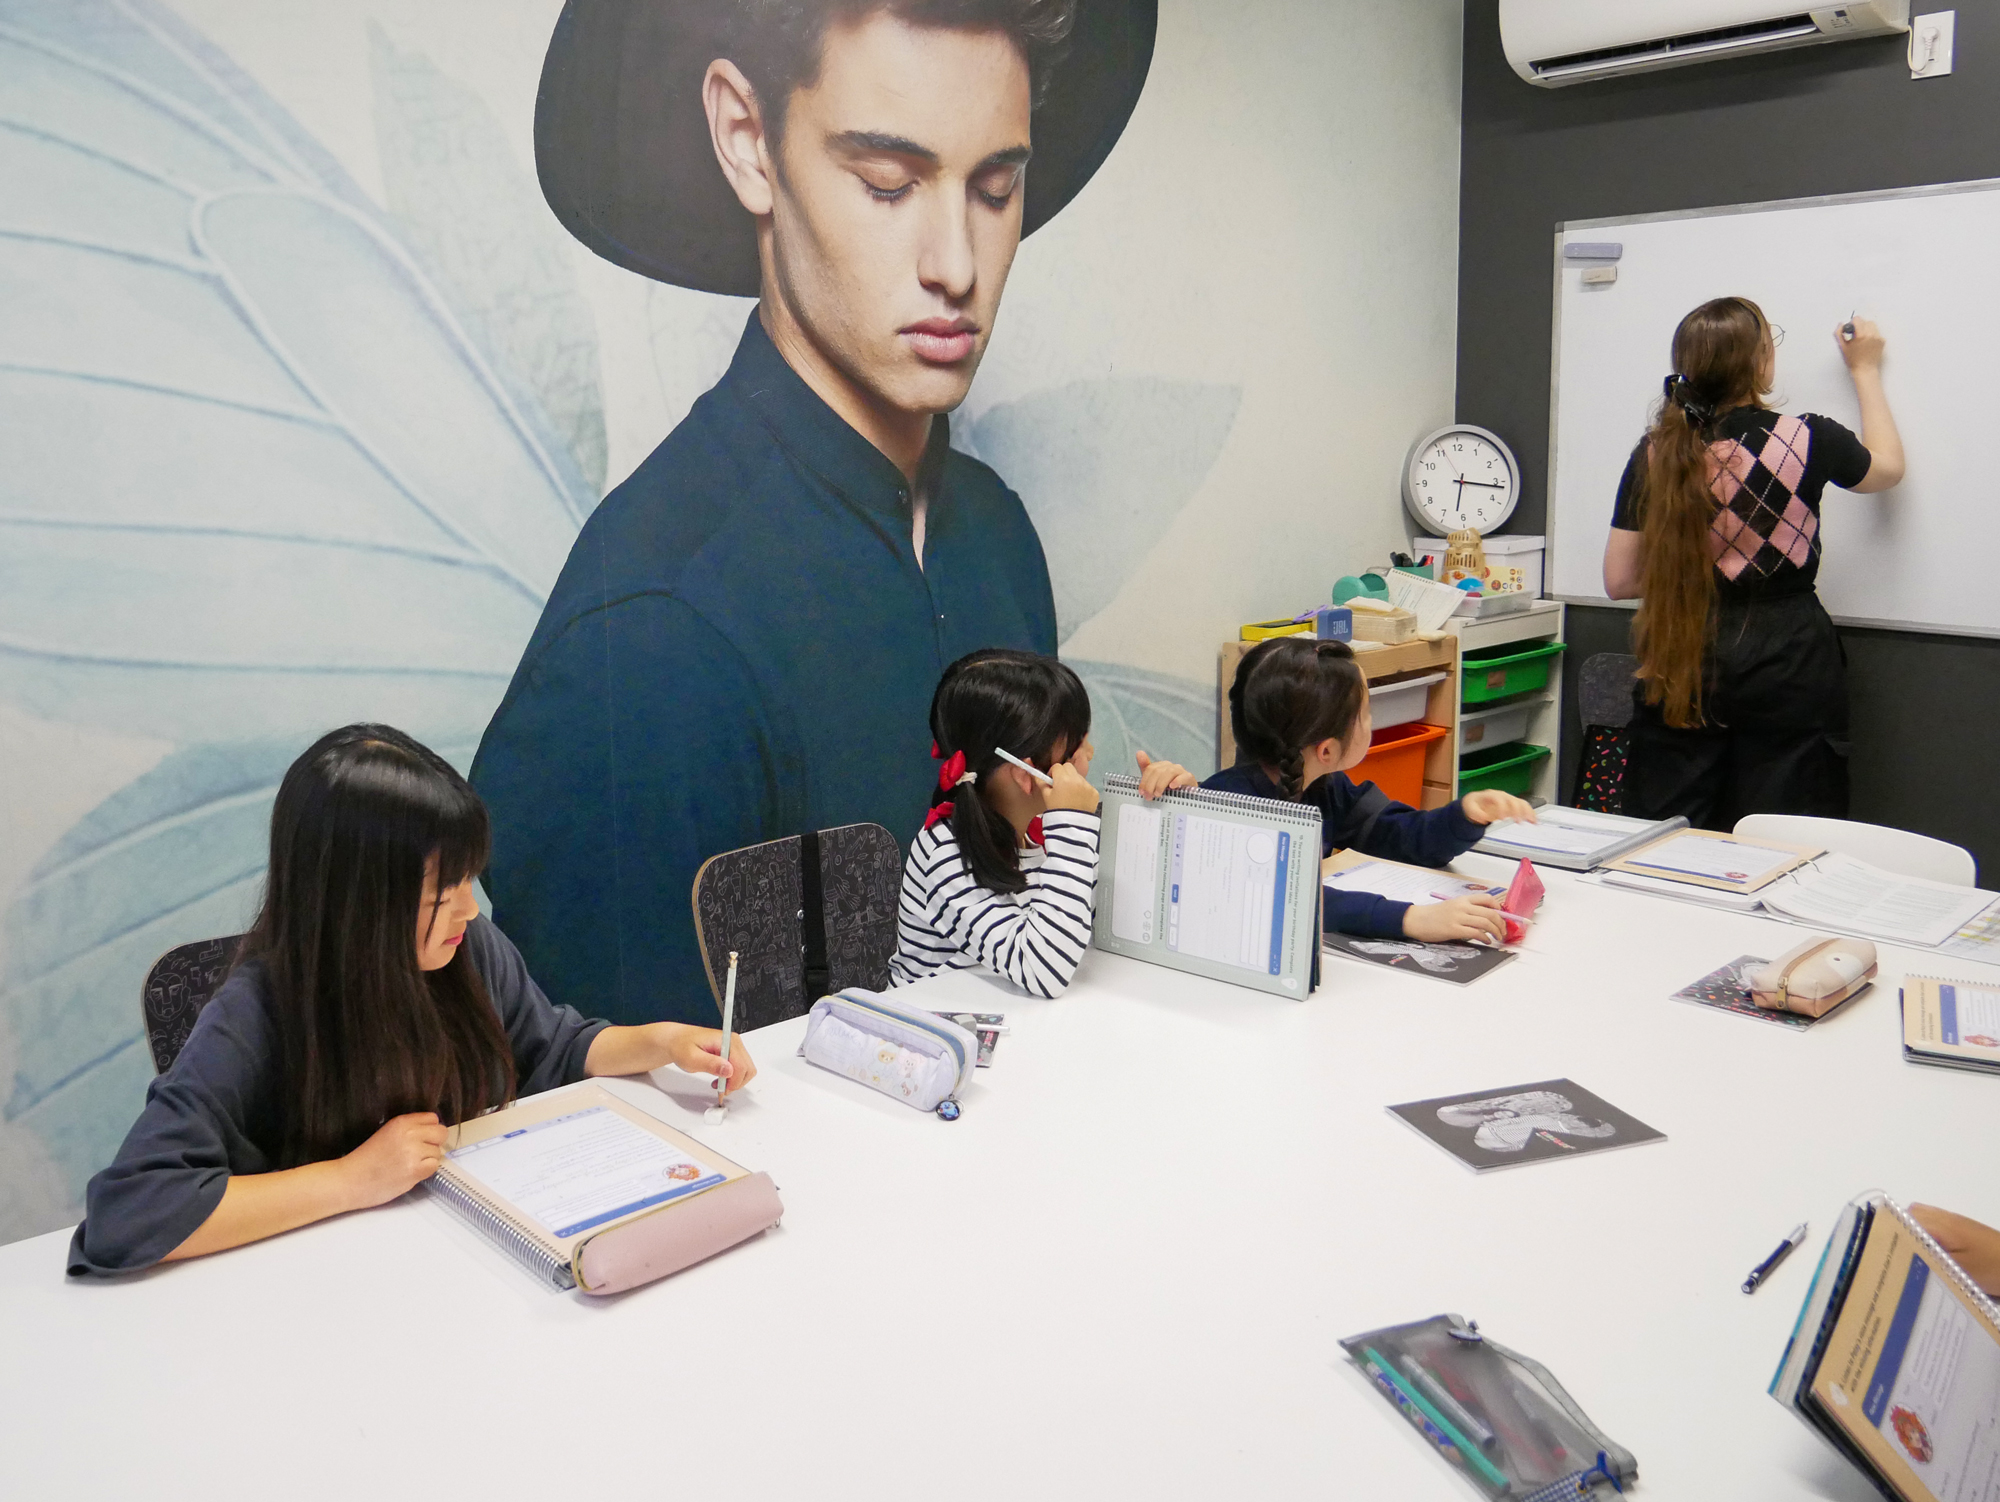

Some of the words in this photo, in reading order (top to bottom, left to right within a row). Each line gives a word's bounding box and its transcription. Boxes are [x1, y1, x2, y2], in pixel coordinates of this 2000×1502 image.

[1493, 478, 1498, 486] 3
[1427, 496, 1433, 504] 8
[1489, 494, 1495, 502] 4
[1441, 509, 1446, 517] 7
[1461, 514, 1466, 522] 6
[1333, 620, 1348, 635] JBL
